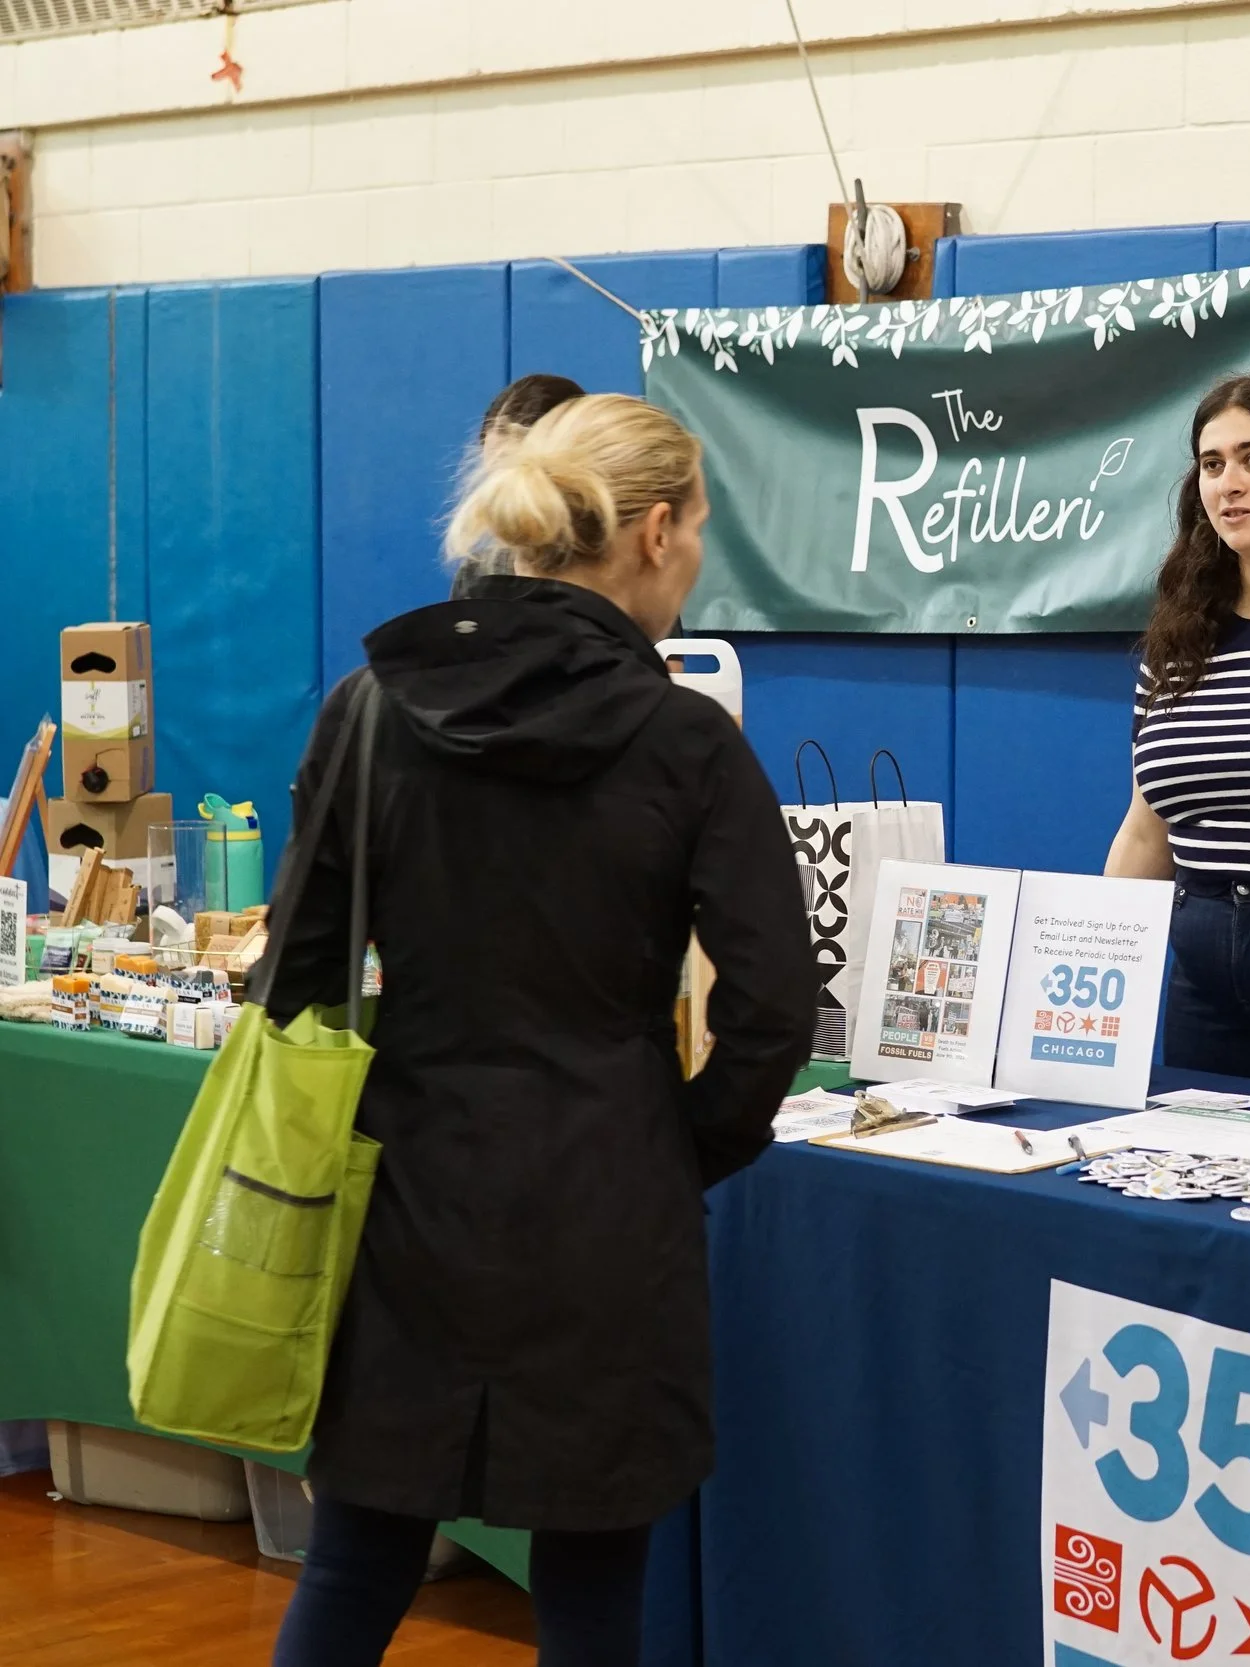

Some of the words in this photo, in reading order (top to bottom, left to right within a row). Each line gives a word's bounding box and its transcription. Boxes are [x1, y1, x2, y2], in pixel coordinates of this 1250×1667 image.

[932, 389, 1002, 442] The
[850, 407, 1104, 573] Refilleri
[1034, 916, 1048, 925] Get
[1050, 917, 1085, 928] Involved!
[1087, 921, 1103, 931] Sign
[1105, 922, 1116, 932] Up
[1119, 922, 1131, 931] for
[1133, 923, 1149, 933] Our
[1040, 931, 1060, 940] Email
[1061, 933, 1077, 942] List
[1079, 935, 1093, 943] and
[1095, 936, 1138, 947] Newsletter
[1033, 945, 1042, 954] To
[1044, 946, 1073, 957] Receive
[1075, 949, 1106, 960] Periodic
[1108, 952, 1143, 963] Updates!
[1048, 964, 1126, 1011] 350
[882, 1030, 918, 1043] PEOPLE
[880, 1046, 906, 1056] FOSSIL
[908, 1049, 932, 1059] FUELS
[1042, 1044, 1105, 1058] CHICAGO
